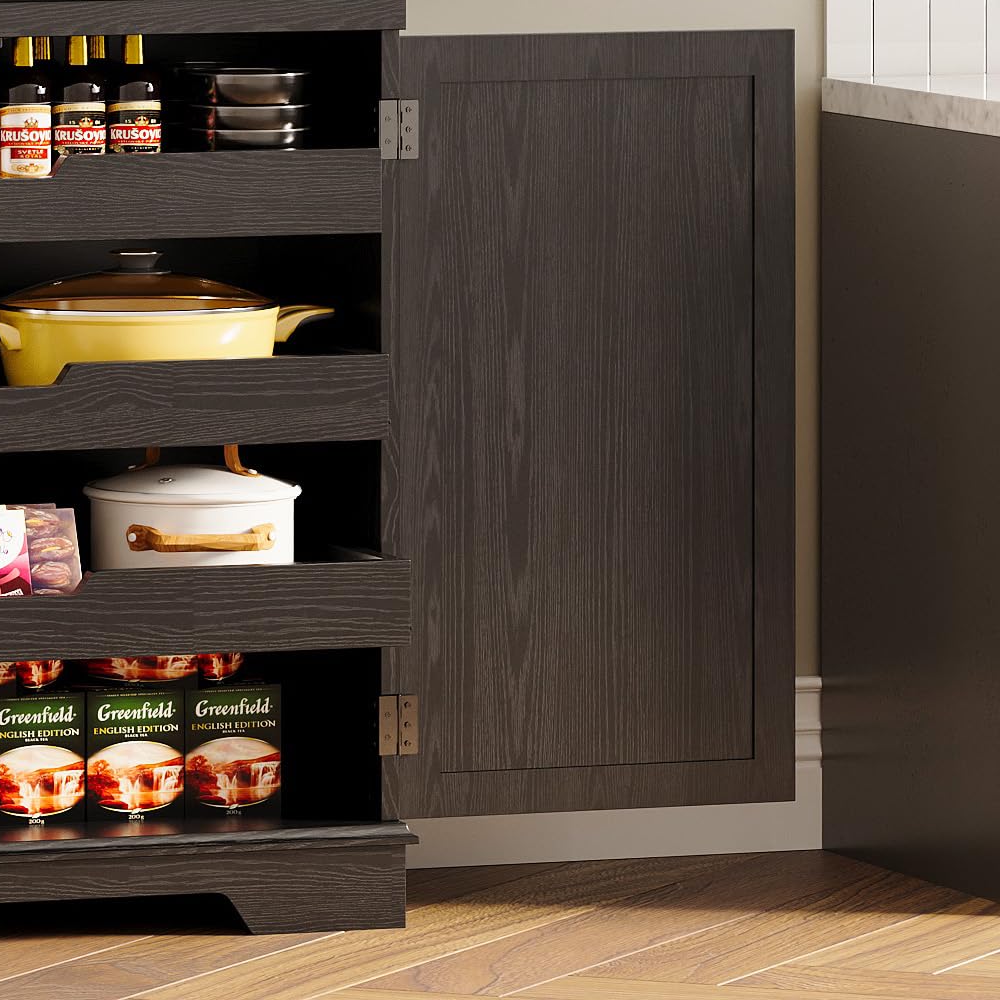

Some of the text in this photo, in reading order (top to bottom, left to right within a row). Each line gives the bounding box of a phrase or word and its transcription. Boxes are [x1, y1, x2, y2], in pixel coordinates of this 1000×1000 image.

[97, 701, 173, 722] Greenfield
[195, 697, 270, 718] Greenfield
[93, 724, 179, 735] ENGLISH EDITION
[191, 720, 276, 731] ENGLISH EDITION
[37, 728, 80, 737] EDITION
